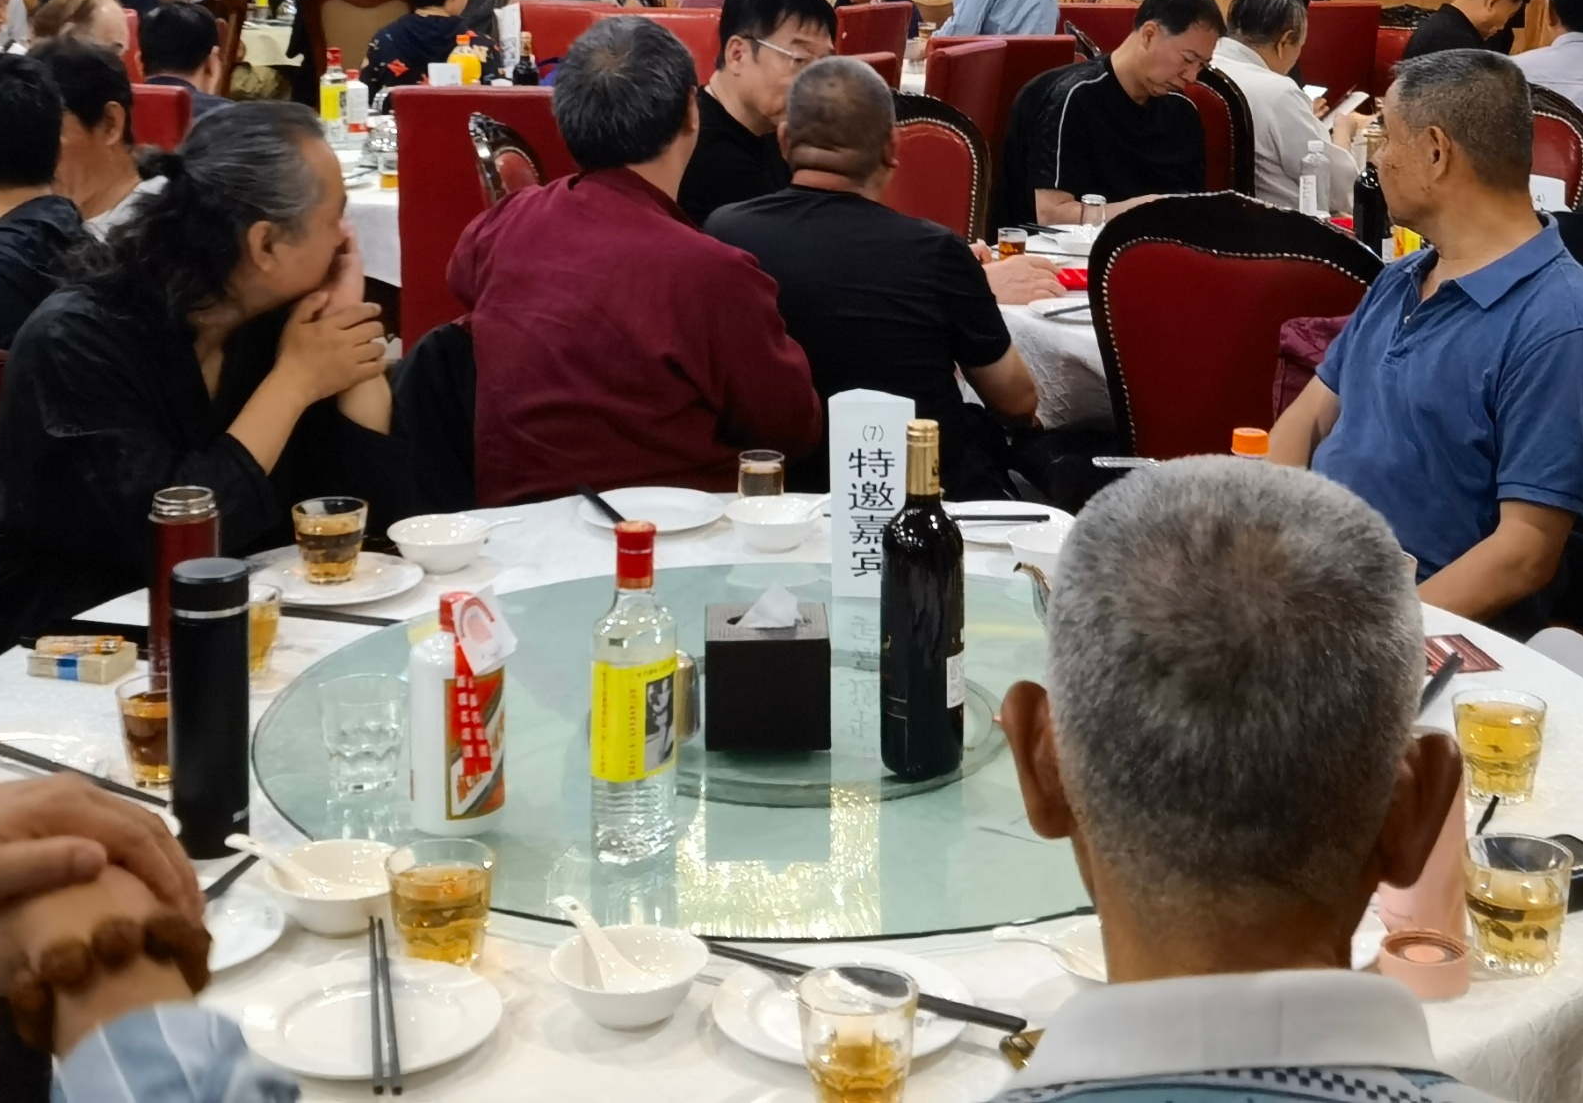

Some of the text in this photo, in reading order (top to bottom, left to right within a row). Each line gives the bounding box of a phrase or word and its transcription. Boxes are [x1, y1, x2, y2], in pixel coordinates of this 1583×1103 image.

[861, 424, 885, 443] (7)
[848, 447, 897, 578] 特邀嘉宾
